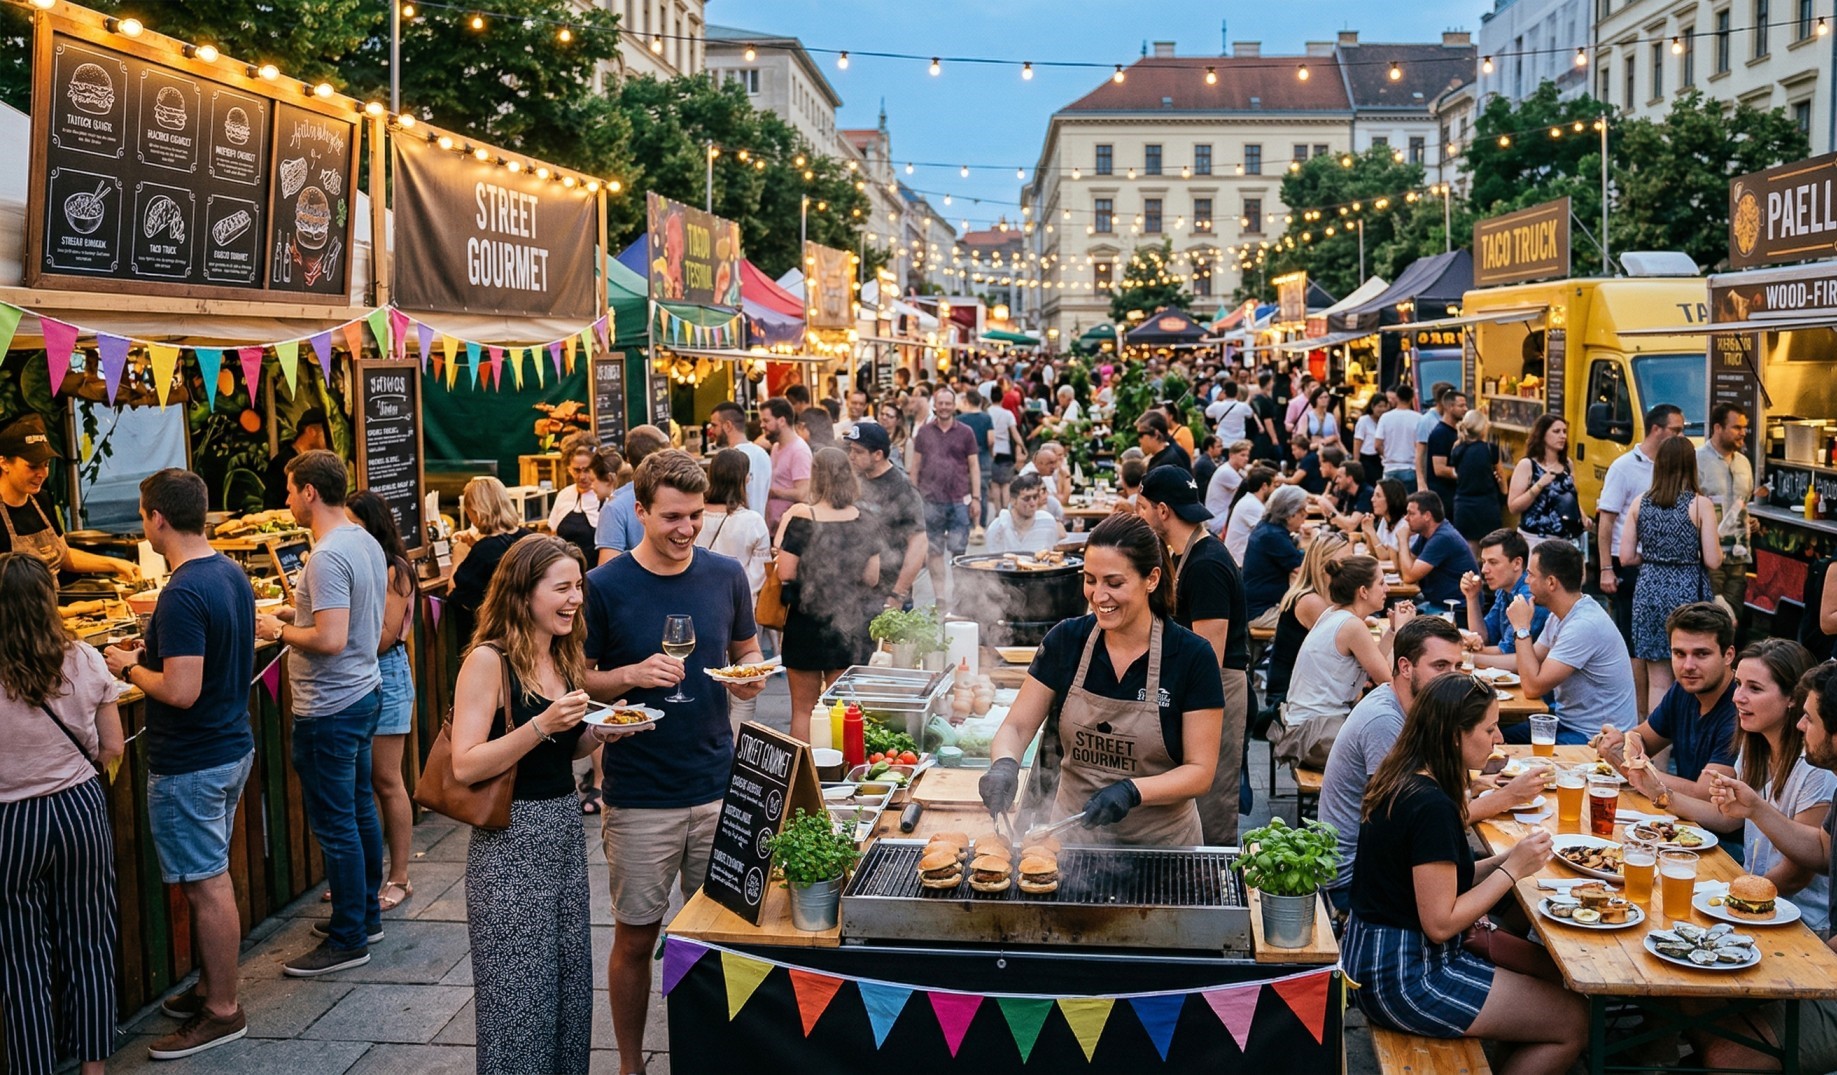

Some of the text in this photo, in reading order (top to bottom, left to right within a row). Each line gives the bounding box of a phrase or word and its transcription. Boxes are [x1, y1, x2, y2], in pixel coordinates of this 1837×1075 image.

[475, 182, 538, 239] STREET
[1767, 180, 1837, 240] PAELL
[467, 237, 549, 292] GOURMET
[1481, 219, 1558, 269] TACO TRUCK
[1766, 280, 1837, 310] WOOD-FIR
[737, 733, 792, 779] STREET GOURMET
[1072, 747, 1138, 772] GOURMET
[1075, 731, 1135, 757] STREET
